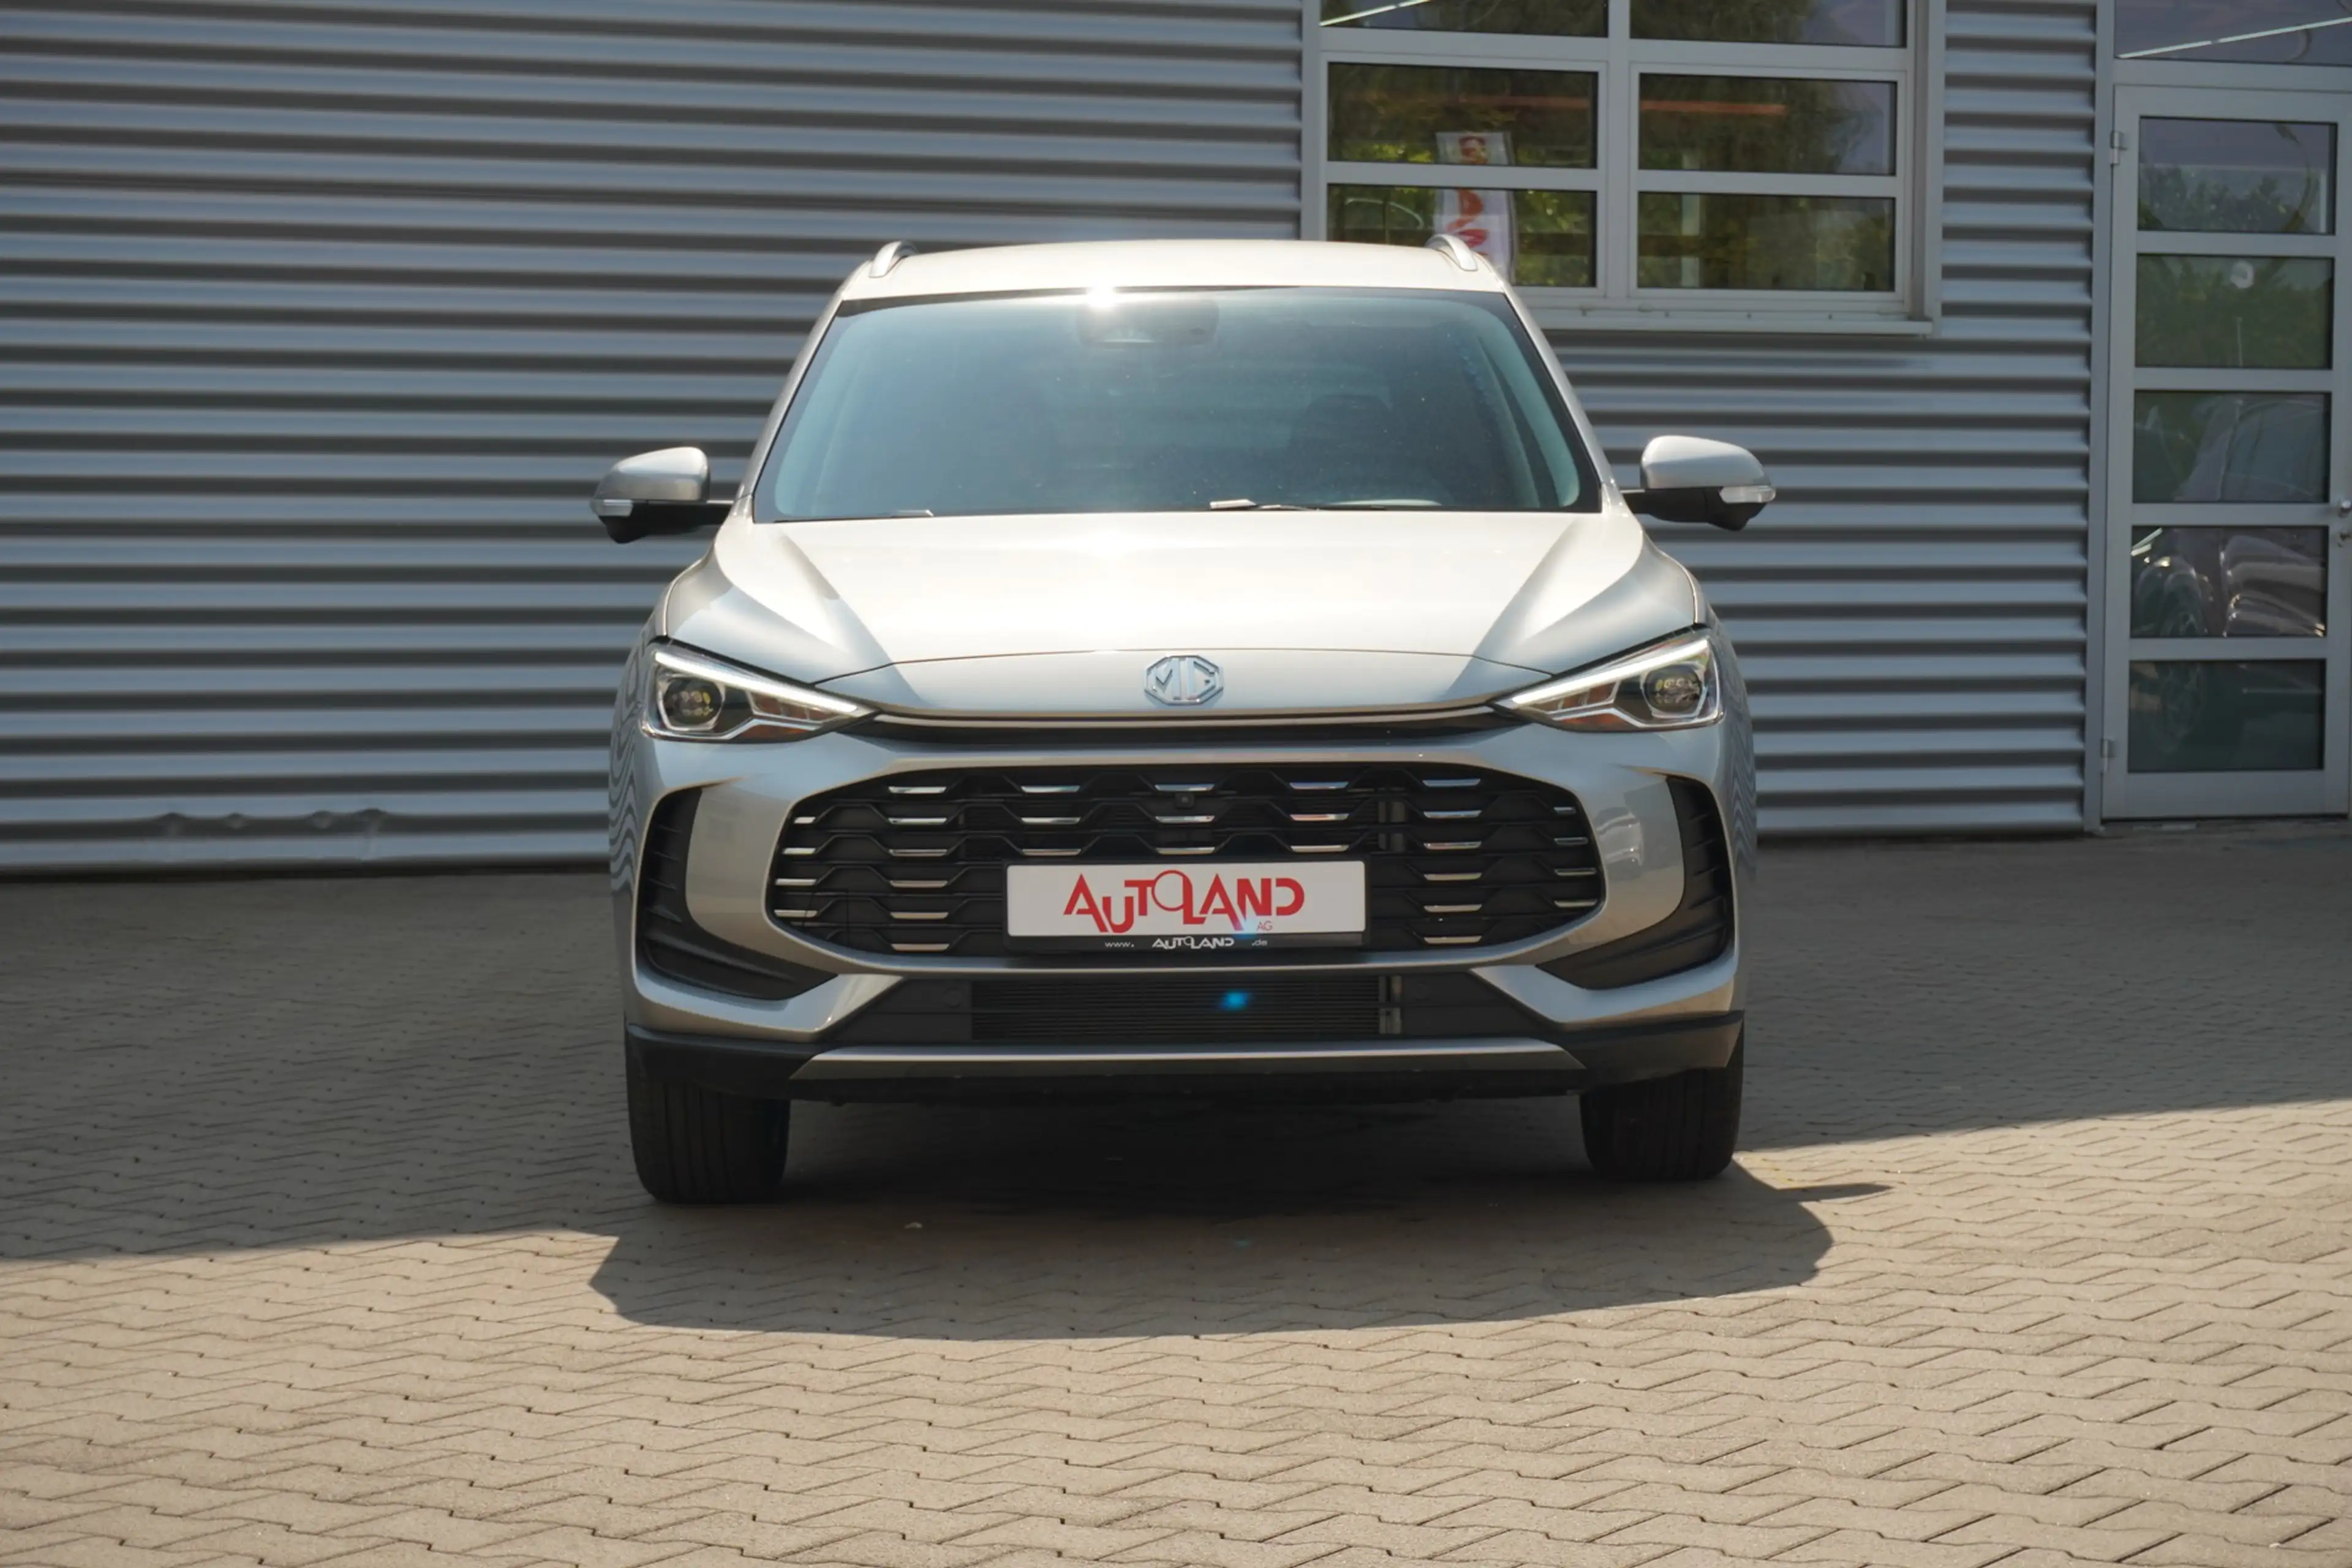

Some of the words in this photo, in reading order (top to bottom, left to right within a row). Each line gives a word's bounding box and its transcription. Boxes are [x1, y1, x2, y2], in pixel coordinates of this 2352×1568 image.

[1146, 655, 1222, 705] MG
[1063, 869, 1305, 934] AUTOLAND
[1257, 920, 1273, 930] AG
[1152, 935, 1235, 949] AUTOLAND
